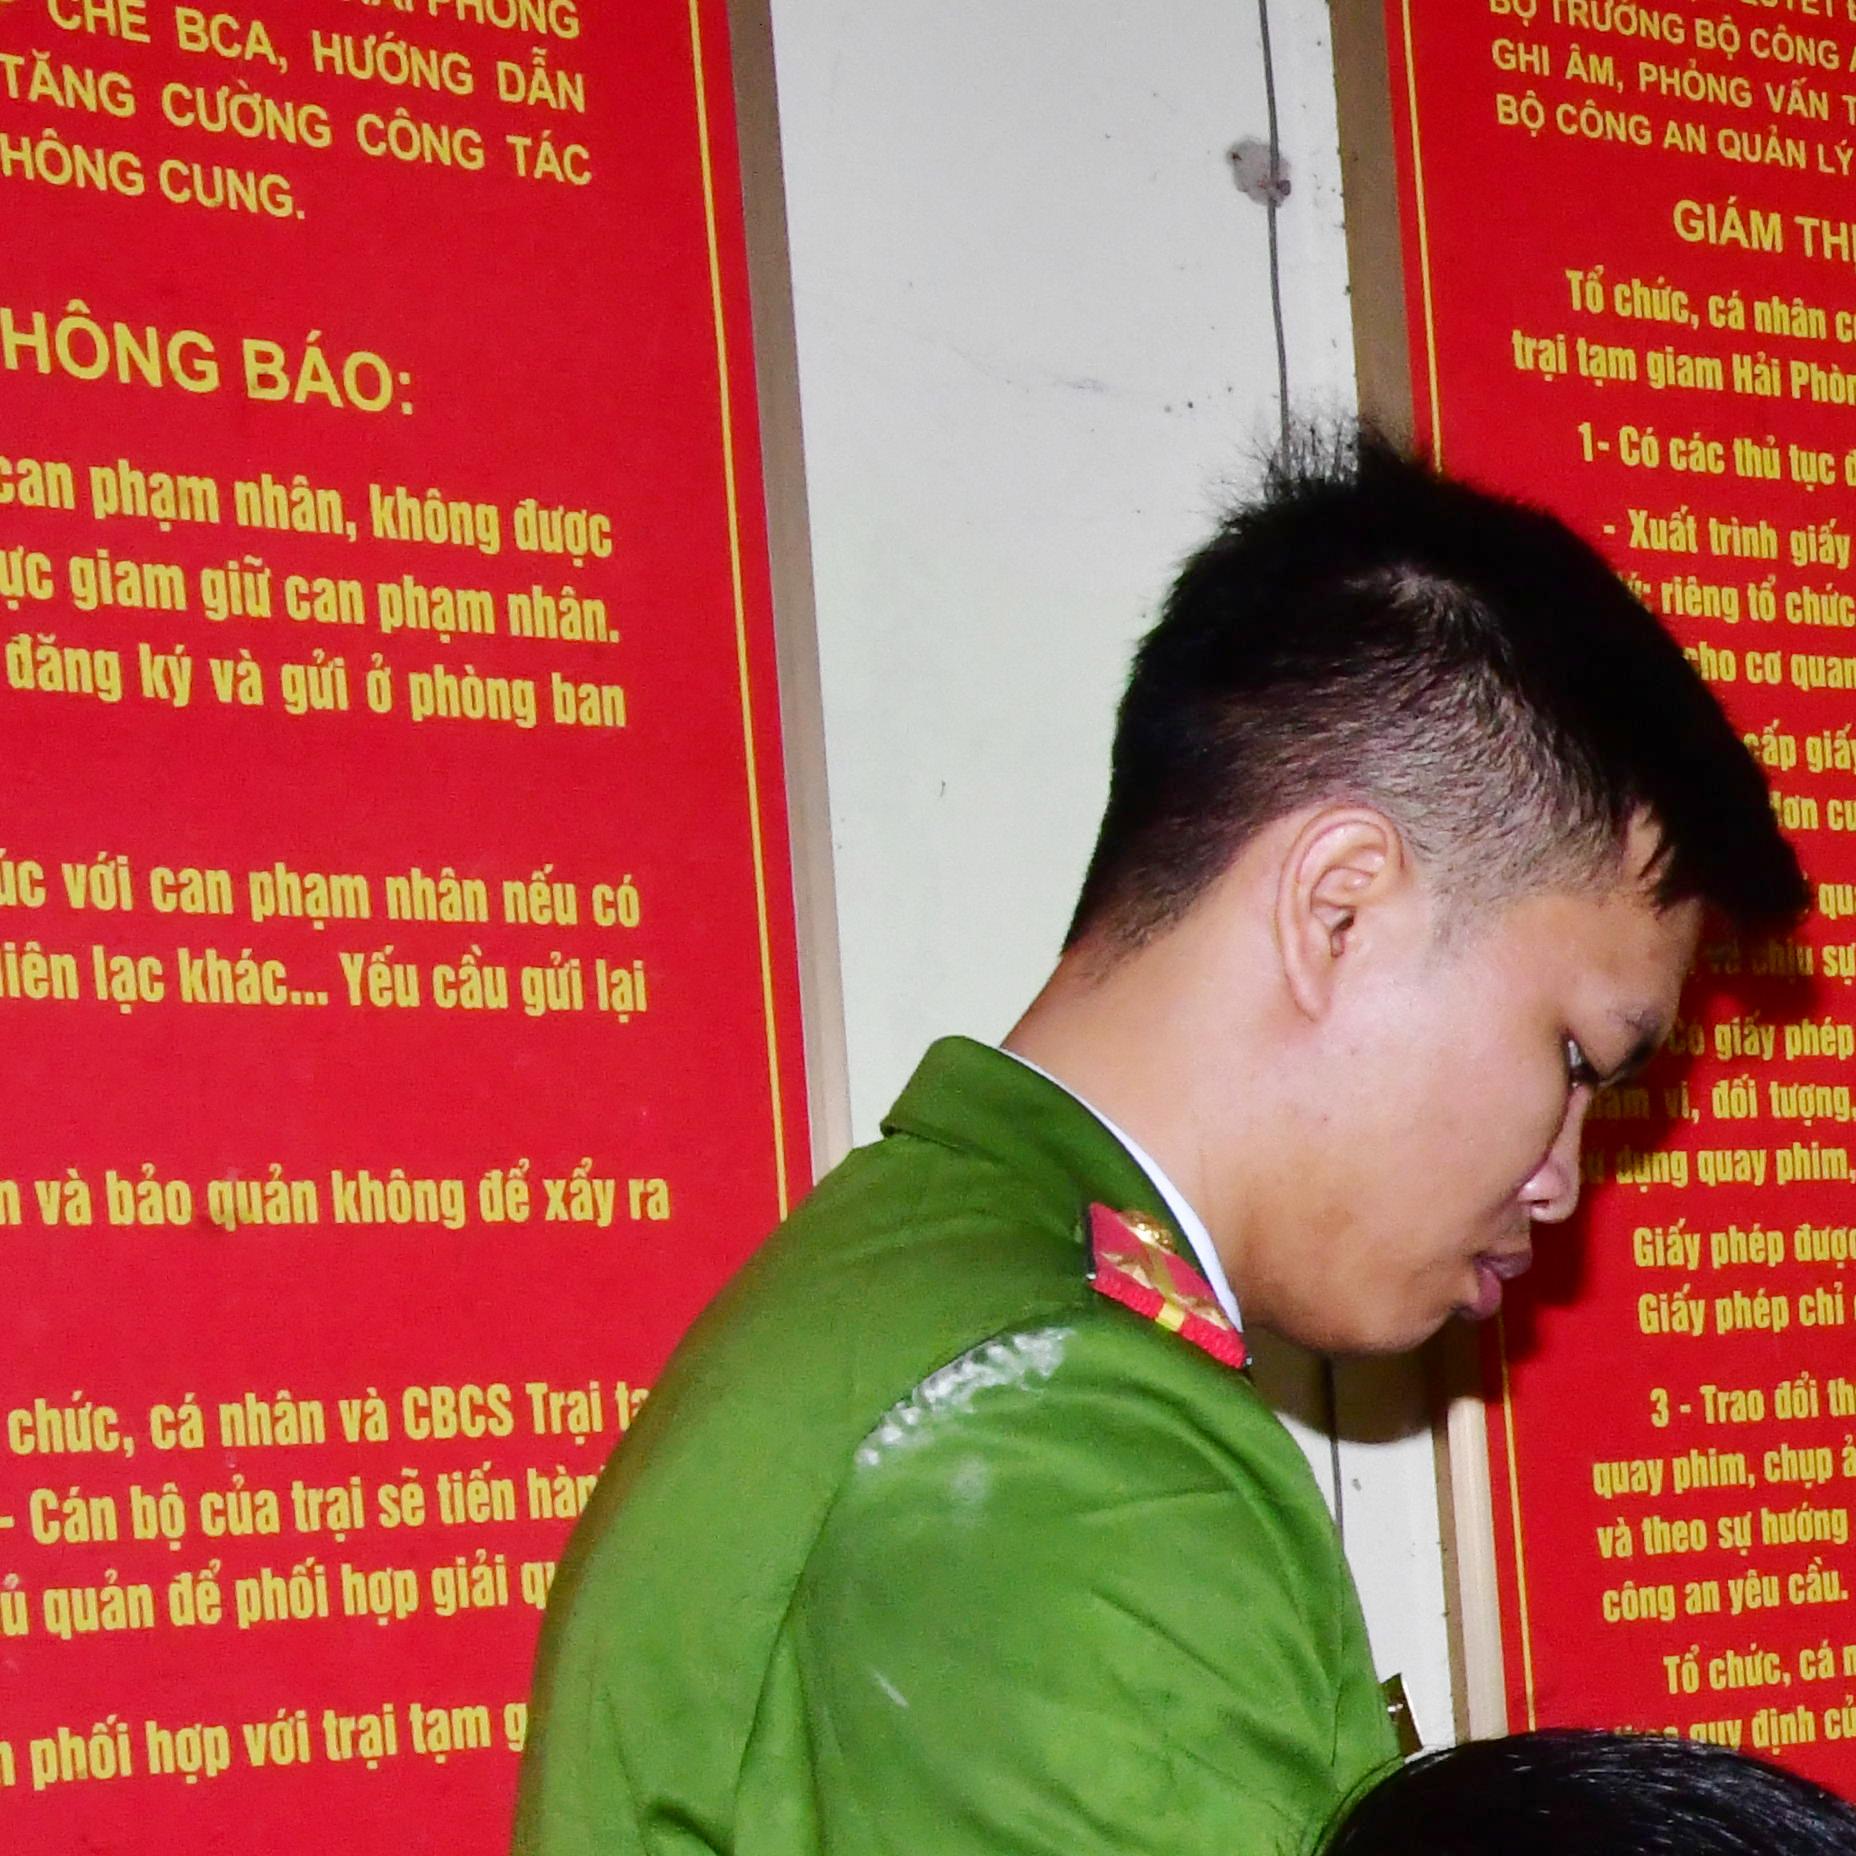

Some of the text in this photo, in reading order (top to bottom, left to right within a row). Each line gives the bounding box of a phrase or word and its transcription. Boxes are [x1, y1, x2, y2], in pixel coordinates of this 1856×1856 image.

[174, 6, 586, 114] BCA, HƯỚNG DẪN
[0, 50, 593, 186] TĂNG CƯỜNG CÔNG TÁC
[158, 159, 304, 220] CUNG.
[1672, 195, 1784, 254] GIÁM
[241, 329, 414, 416] BÁO:
[1618, 425, 1661, 469] Có
[1668, 431, 1726, 475] các
[1732, 435, 1782, 481] thủ
[1788, 443, 1837, 492] tục
[88, 457, 221, 533] phạm
[233, 472, 358, 544] nhân,
[368, 483, 502, 556] không
[512, 497, 614, 569] được
[67, 547, 621, 644] giam giữ can phạm nhân.
[4, 632, 627, 729] đăng ký và gửi ở phòng ban
[60, 851, 641, 931] với can phạm nhân nếu có
[91, 943, 167, 1015] lạc
[176, 946, 329, 1007] khác...
[431, 943, 510, 1011] cầu
[520, 950, 585, 1018] gửi
[594, 958, 648, 1025] lại
[34, 1167, 94, 1227] và
[104, 1162, 196, 1227] bảo
[206, 1162, 321, 1233] quản
[330, 1167, 467, 1231] không
[477, 1157, 532, 1224] để
[627, 1177, 673, 1222] ra
[7, 1390, 136, 1457] chức,
[148, 1392, 206, 1451] cá
[218, 1389, 327, 1448] nhân
[337, 1387, 390, 1444] và
[401, 1382, 516, 1441] CBCS
[524, 1380, 605, 1436] Trại
[28, 1460, 518, 1552] Cán bộ của trại sẽ tiến
[42, 1567, 156, 1641] quản
[167, 1558, 223, 1628] để
[234, 1555, 330, 1630] phối
[339, 1562, 420, 1627] hợp
[430, 1547, 510, 1617] giải
[28, 1714, 134, 1792] phối
[144, 1719, 232, 1785] hợp
[241, 1708, 312, 1768] với
[321, 1702, 399, 1771] trại
[407, 1702, 493, 1765] tạm
